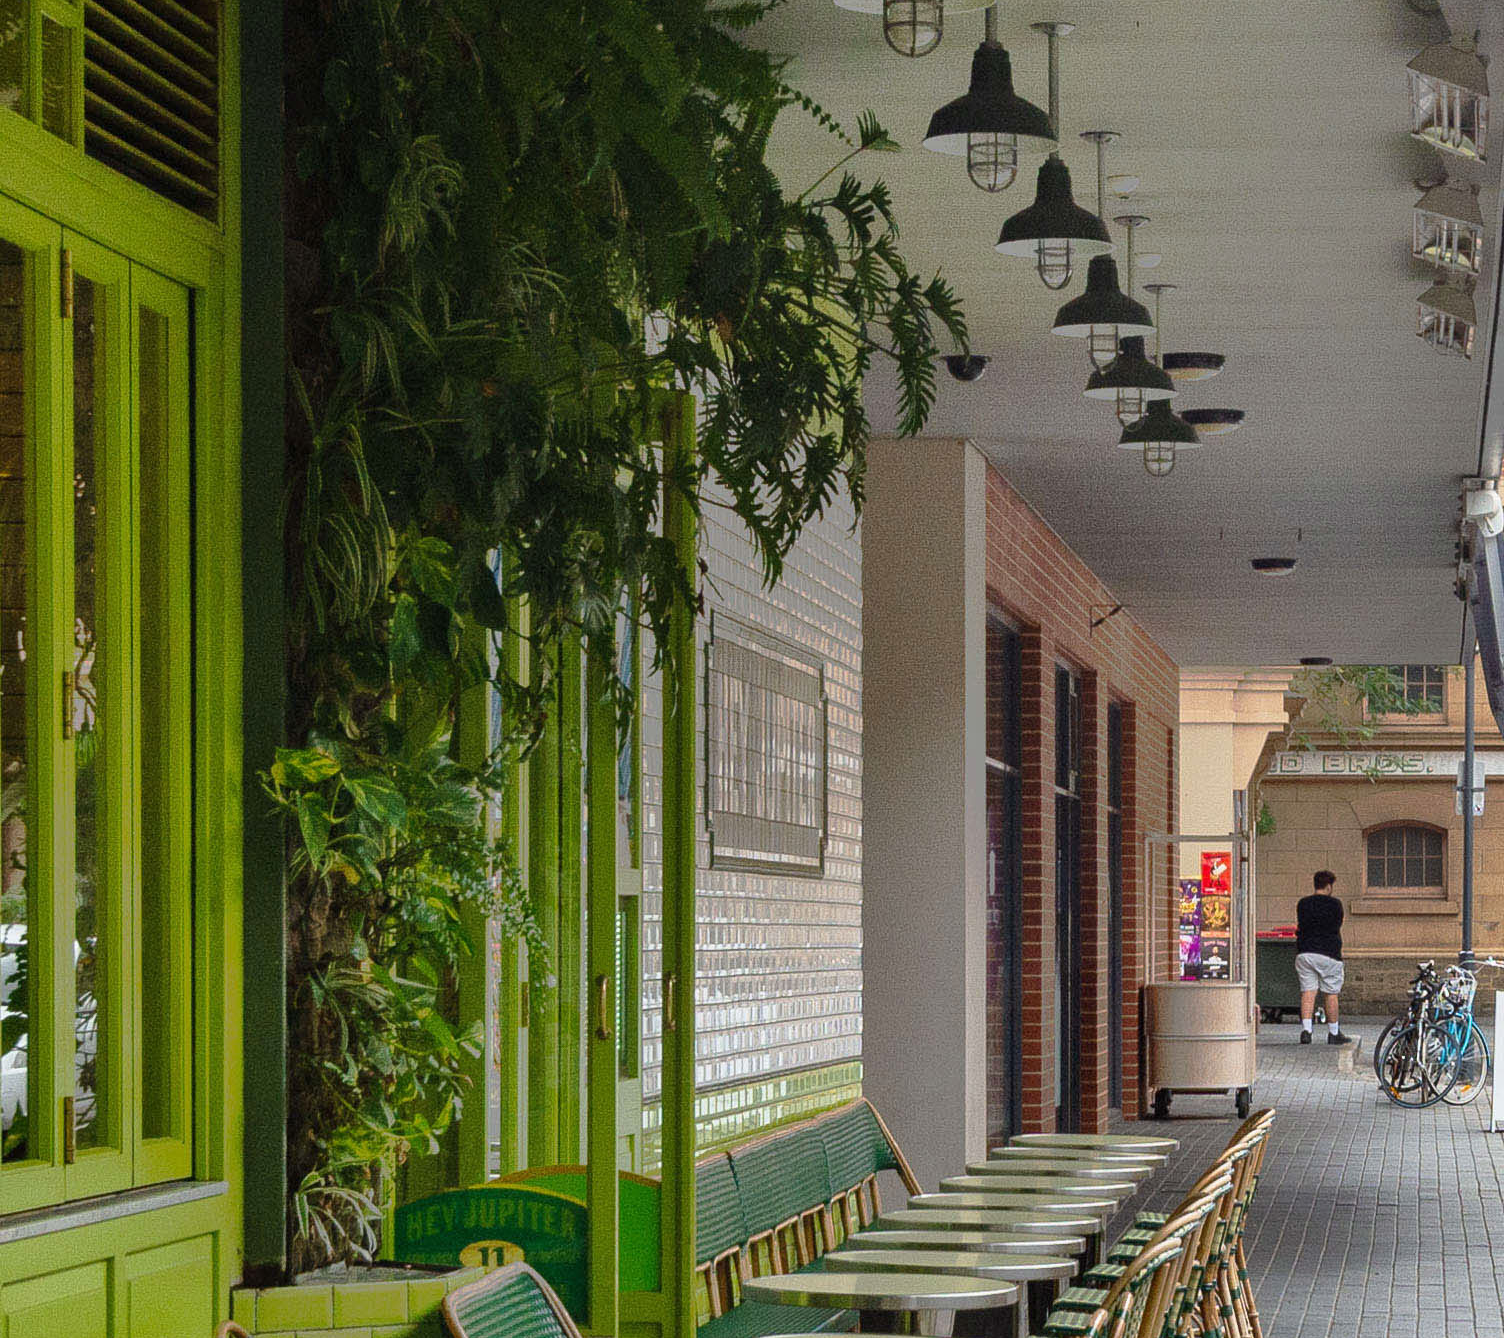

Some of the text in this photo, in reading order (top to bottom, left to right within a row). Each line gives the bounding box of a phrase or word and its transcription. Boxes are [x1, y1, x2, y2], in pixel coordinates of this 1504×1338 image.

[407, 1199, 576, 1241] HEY JUPITER
[478, 1247, 504, 1267] 11
